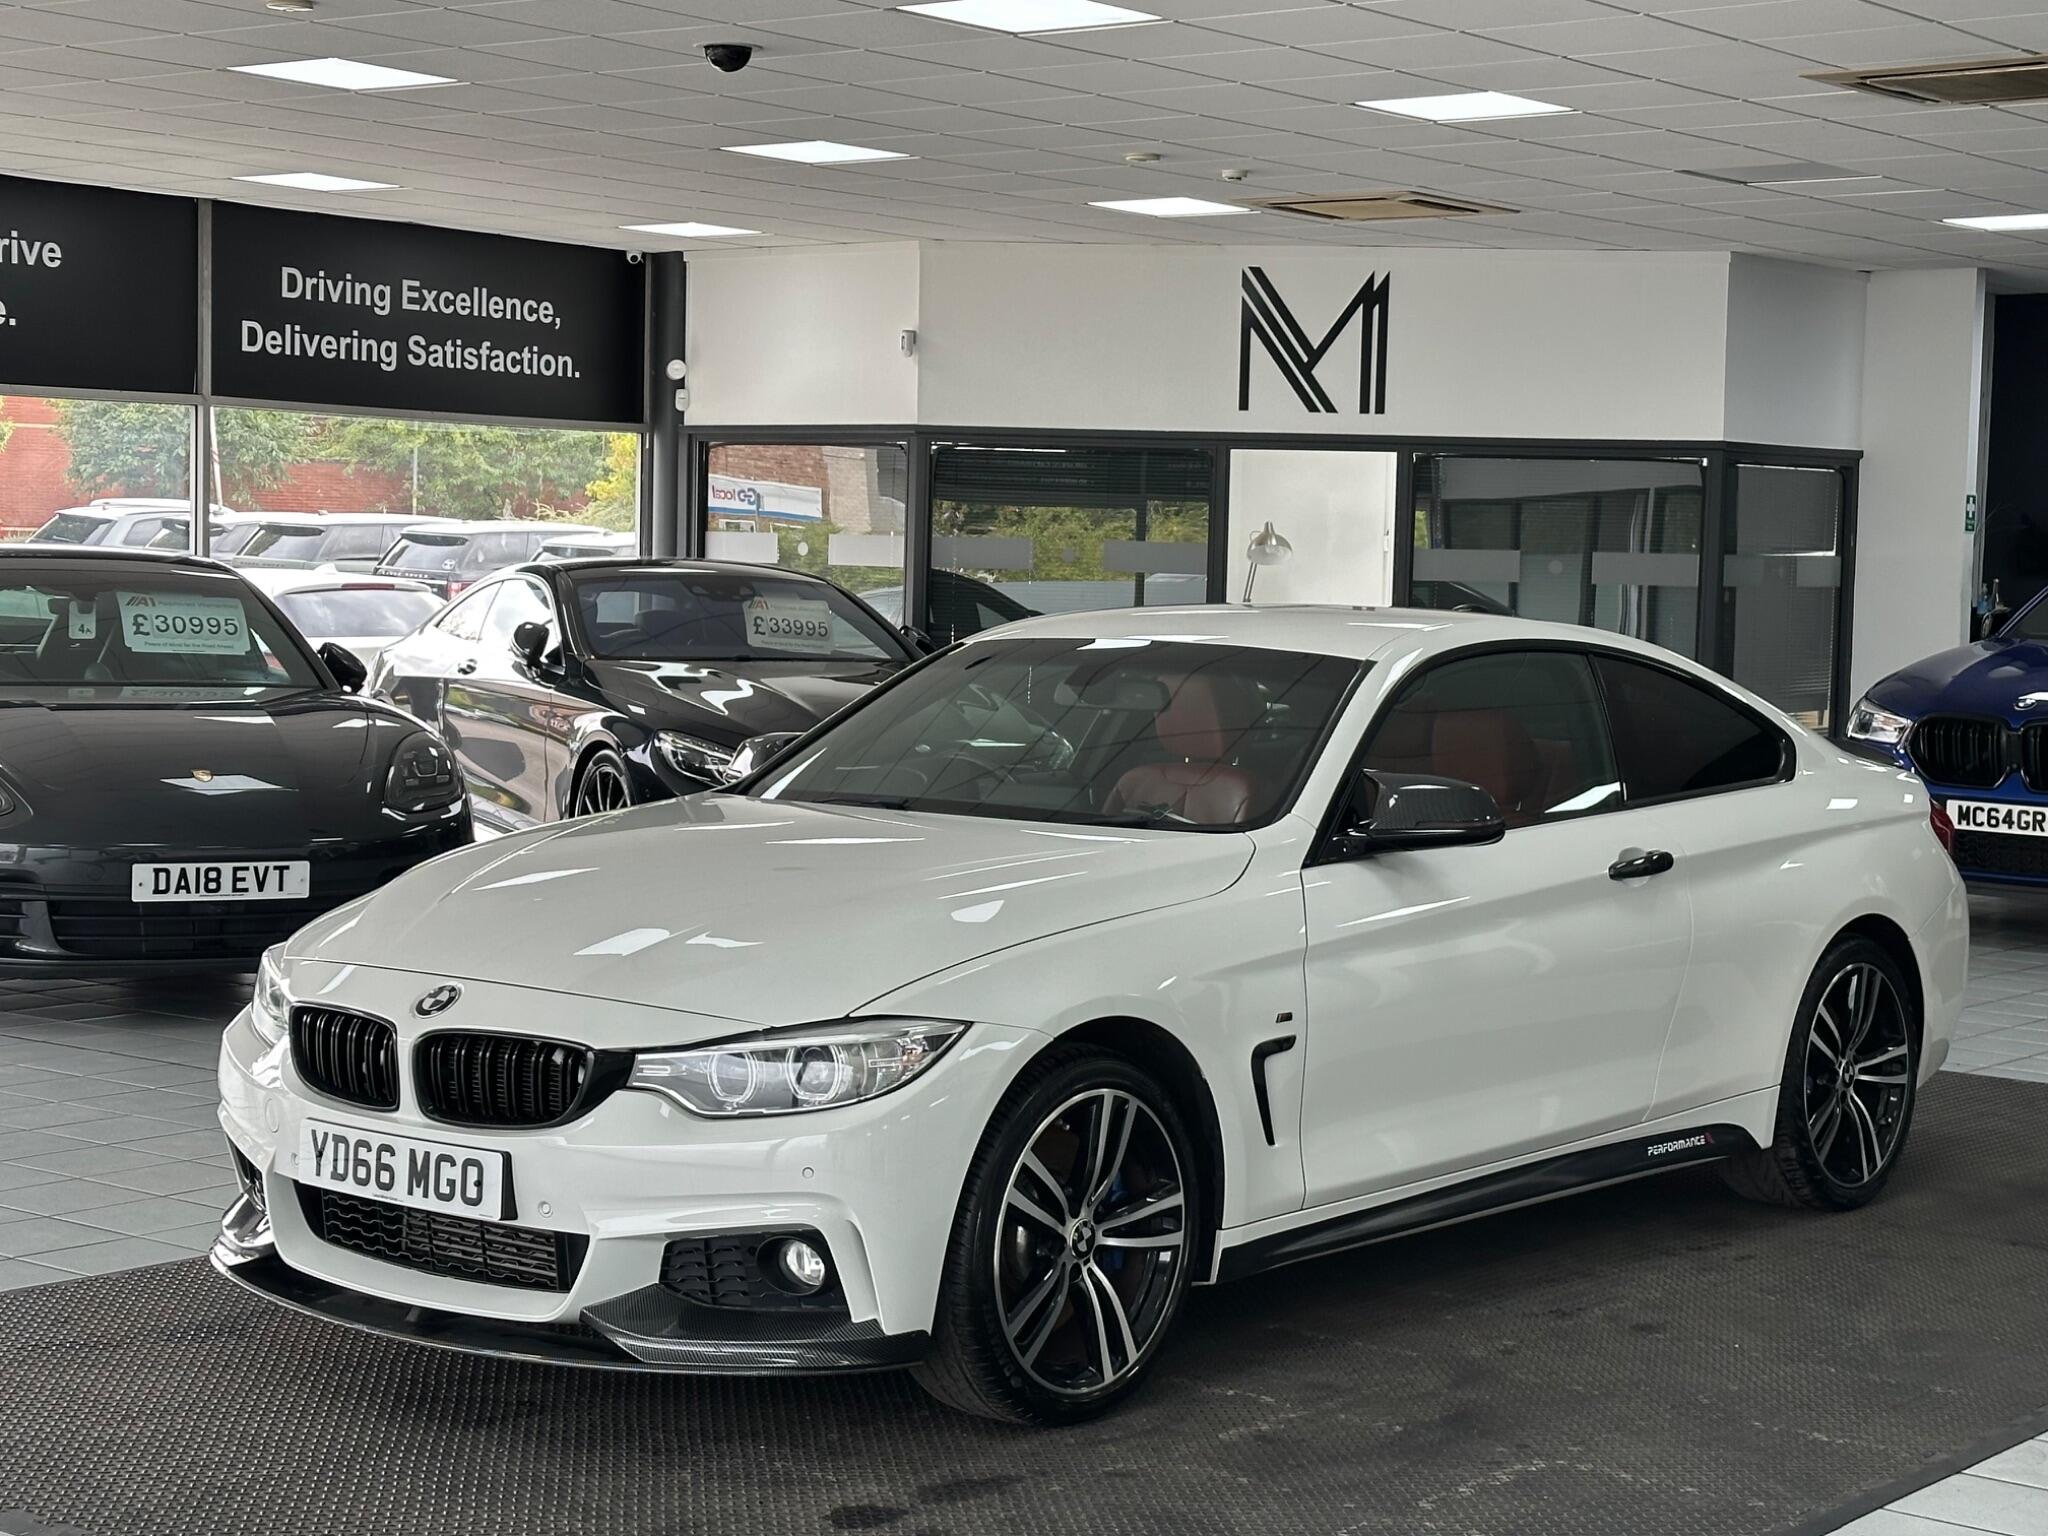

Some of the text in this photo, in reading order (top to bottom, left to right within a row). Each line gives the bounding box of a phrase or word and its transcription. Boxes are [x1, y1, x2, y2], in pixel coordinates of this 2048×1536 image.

[281, 266, 561, 329] Driving Excellence,
[241, 320, 580, 378] Delivering Satisfaction.
[132, 613, 238, 636] £30995
[753, 616, 828, 637] £33995
[152, 865, 290, 895] DA18 EVT
[1648, 1135, 1705, 1157] PERFORMANCE
[312, 1129, 484, 1207] YD66 MGO
